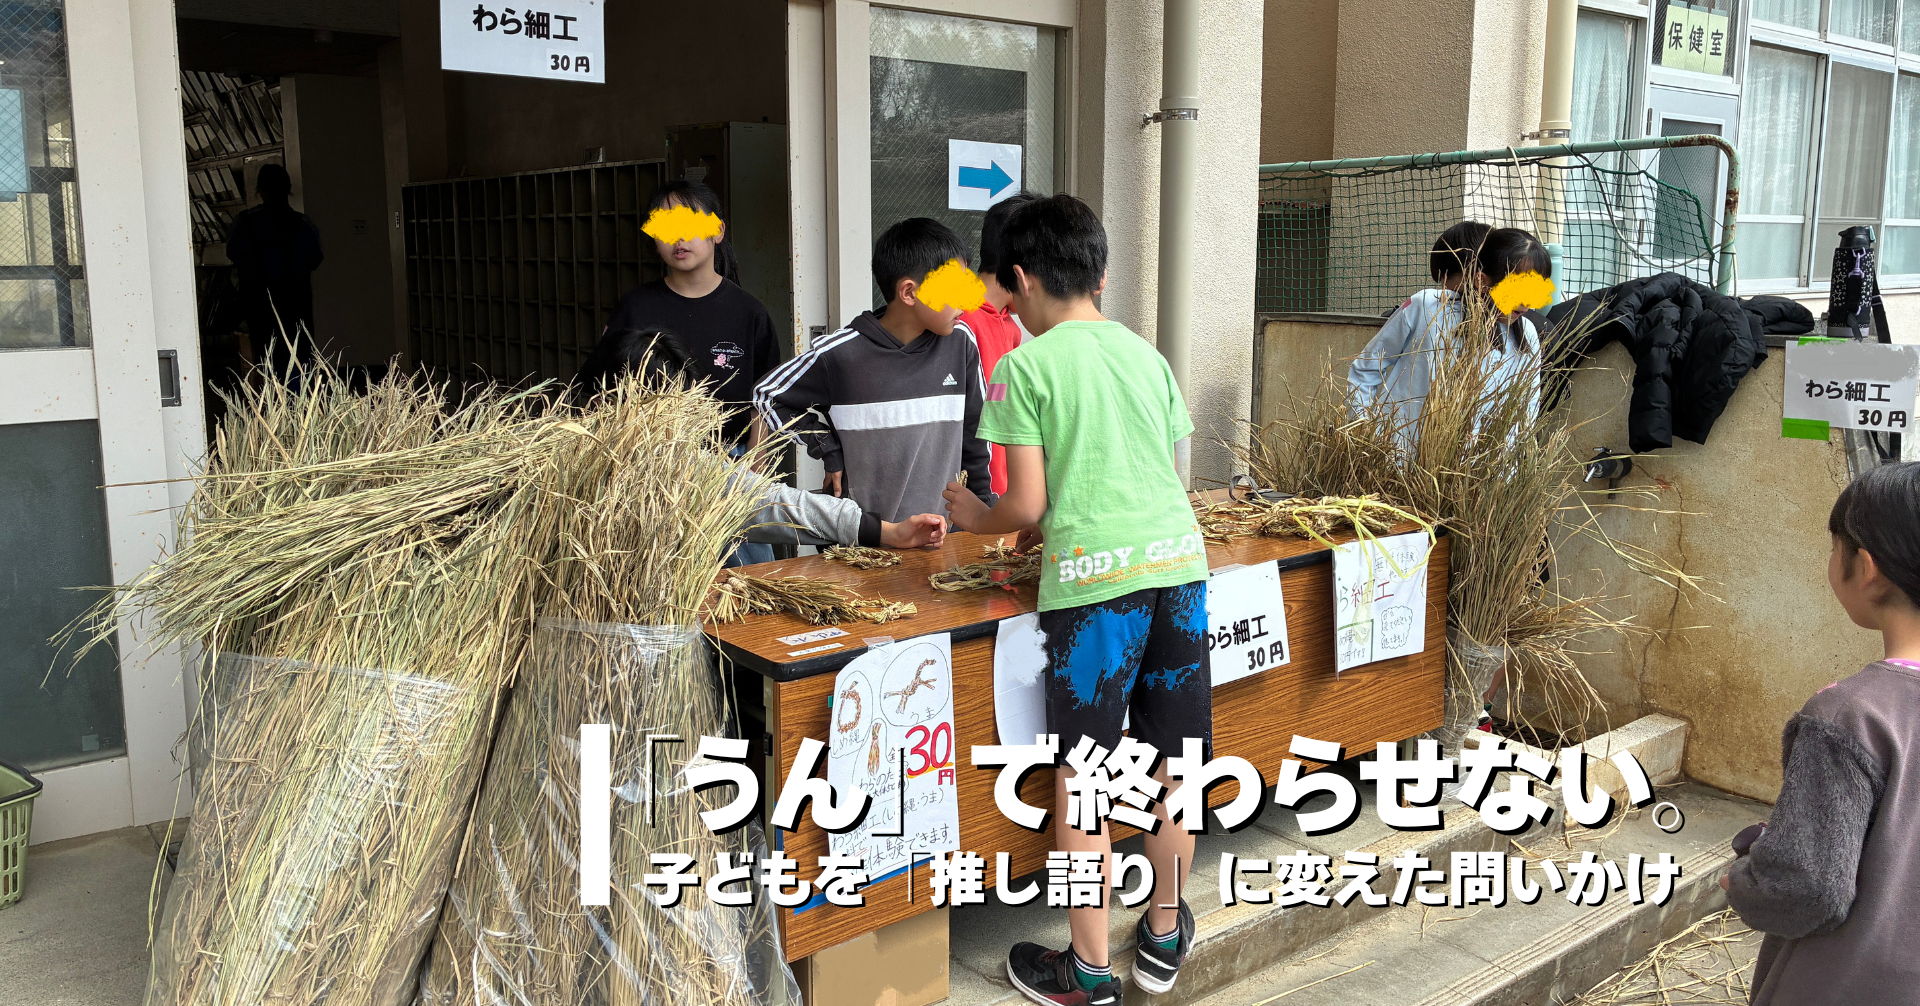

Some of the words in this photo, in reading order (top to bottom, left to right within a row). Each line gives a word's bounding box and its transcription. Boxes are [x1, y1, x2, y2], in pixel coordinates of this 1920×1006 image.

[472, 4, 579, 42] わら細工
[1668, 20, 1724, 57] 保健室
[1805, 379, 1891, 403] わら細工
[1059, 546, 1134, 583] BODY
[1076, 569, 1125, 587] WORLDWIDE
[910, 707, 935, 724] うま
